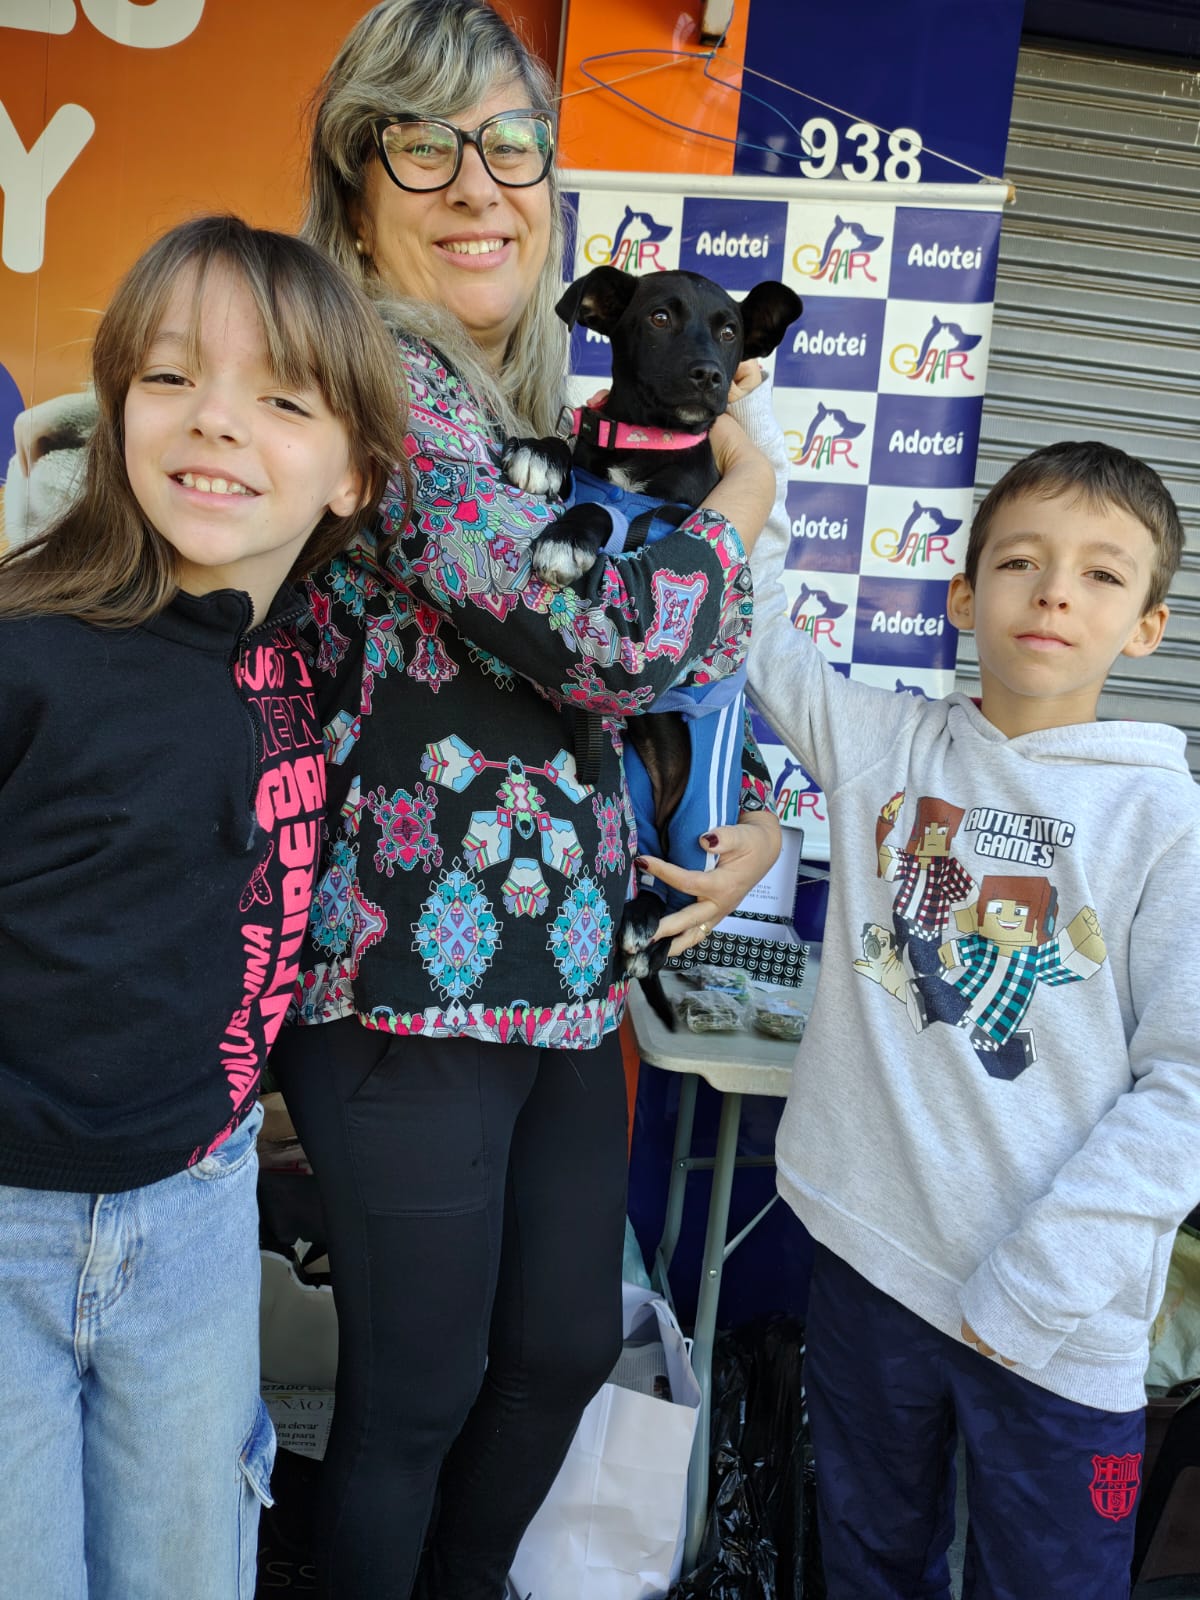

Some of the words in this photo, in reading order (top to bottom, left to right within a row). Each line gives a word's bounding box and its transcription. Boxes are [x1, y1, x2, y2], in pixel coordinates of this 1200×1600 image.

[799, 117, 923, 183] 938
[583, 233, 667, 273] GAAR
[696, 230, 769, 258] Adotei
[907, 243, 982, 270] Adotei
[792, 244, 878, 284] GAAR
[792, 330, 867, 357] Adotei
[888, 343, 976, 383] GAAR
[888, 429, 964, 455] Adotei
[792, 513, 848, 540] dotei
[870, 527, 956, 567] GAAR
[793, 614, 842, 648] AAR
[871, 610, 944, 637] Adotei
[776, 788, 825, 822] AAR
[965, 808, 1075, 847] AUTHENTIC
[975, 834, 1054, 868] GAMES
